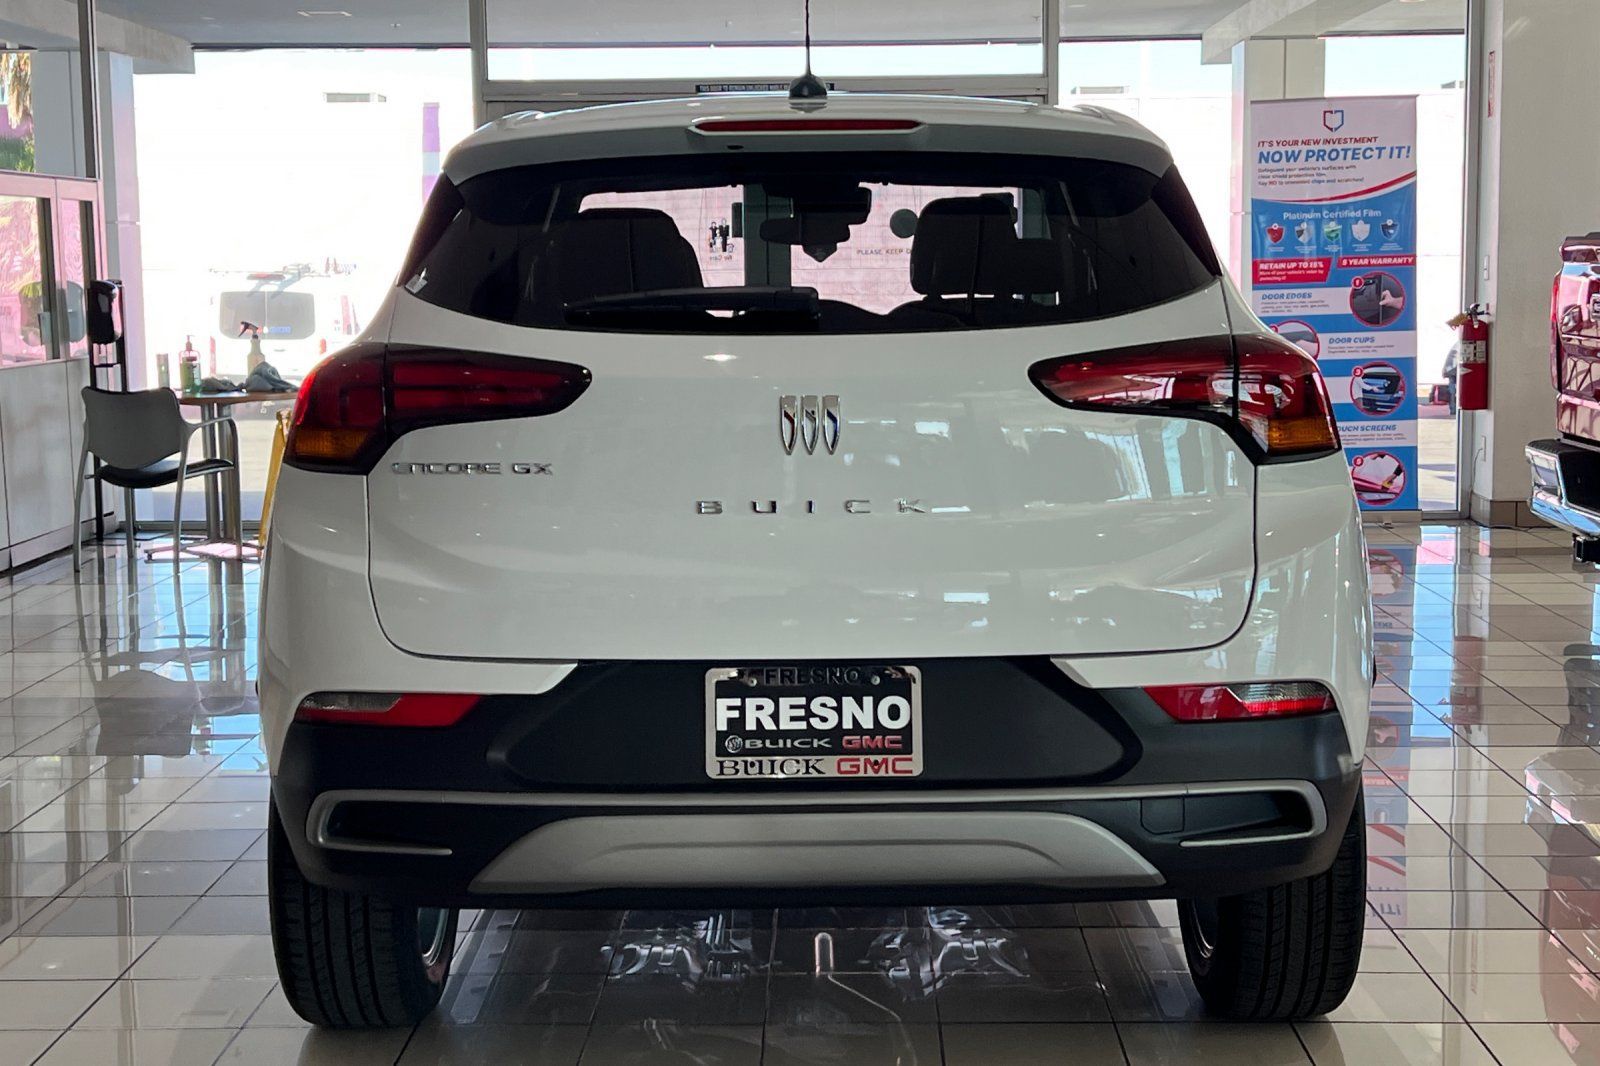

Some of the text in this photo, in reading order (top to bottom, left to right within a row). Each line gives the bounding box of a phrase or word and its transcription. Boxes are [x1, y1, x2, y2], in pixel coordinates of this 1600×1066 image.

[1257, 136, 1379, 148] IT'S YOUR NEW INVESTMENT
[1258, 145, 1412, 164] NOW PROTECT IT!
[1283, 209, 1382, 220] Platinum Certified Film
[1259, 262, 1287, 270] RETAIN
[1349, 258, 1370, 266] YEAR
[1370, 256, 1415, 265] WARRANTY
[1261, 291, 1312, 300] DOOR EDGES
[1328, 335, 1376, 345] DOOR CUPS
[1359, 423, 1398, 432] SCREENS
[511, 462, 553, 476] GX
[697, 499, 926, 515] BUICK
[762, 666, 864, 686] FRESNO
[715, 696, 911, 731] FRESNO
[745, 735, 903, 749] BUICK GMC
[716, 757, 913, 777] BUICK GMC
